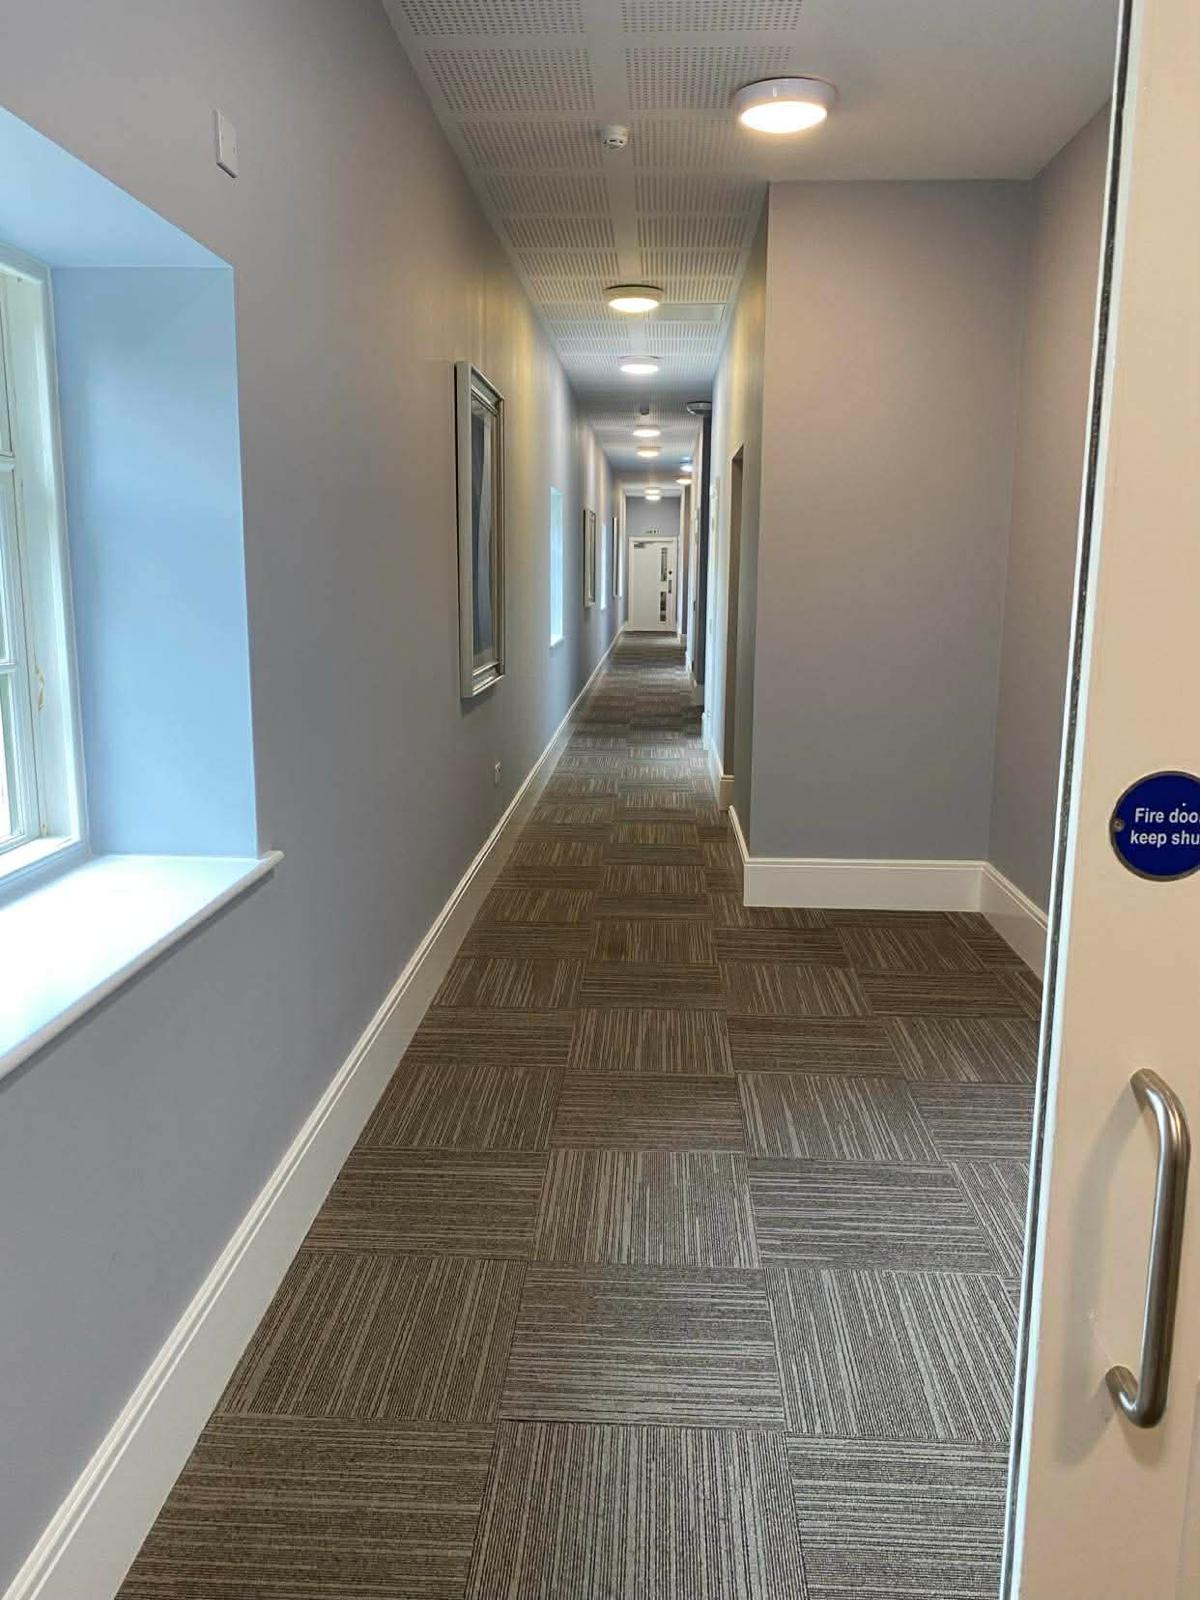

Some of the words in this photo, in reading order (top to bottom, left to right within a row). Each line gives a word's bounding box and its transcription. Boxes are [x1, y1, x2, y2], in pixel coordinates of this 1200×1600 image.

[1135, 807, 1165, 823] Fire
[1169, 807, 1200, 823] doo
[1130, 830, 1167, 848] keep
